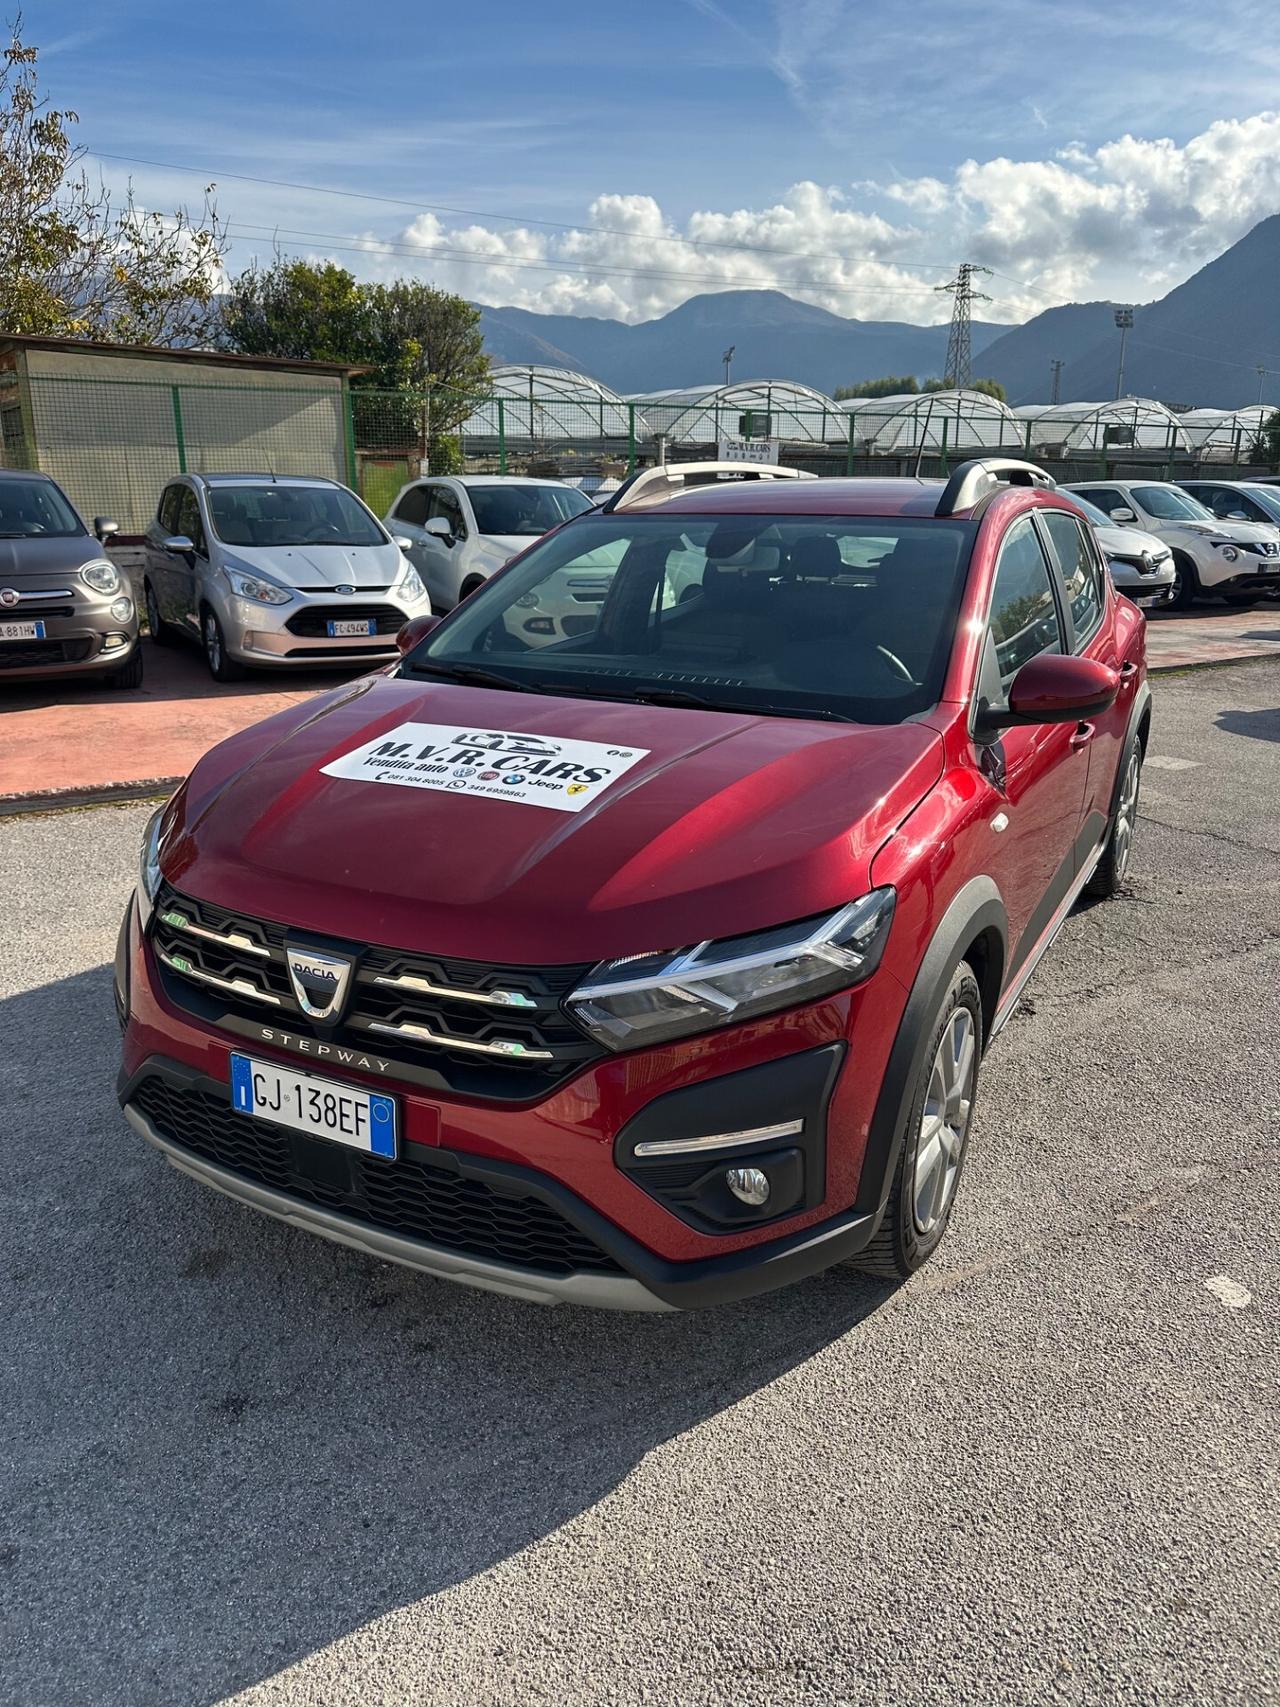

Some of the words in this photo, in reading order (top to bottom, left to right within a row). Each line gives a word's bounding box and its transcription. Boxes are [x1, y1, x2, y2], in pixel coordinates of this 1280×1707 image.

[362, 757, 415, 770] Vendita
[414, 764, 449, 774] auto
[528, 780, 564, 791] Jeep
[293, 962, 337, 981] DACIA
[261, 1028, 390, 1072] STEPWAY
